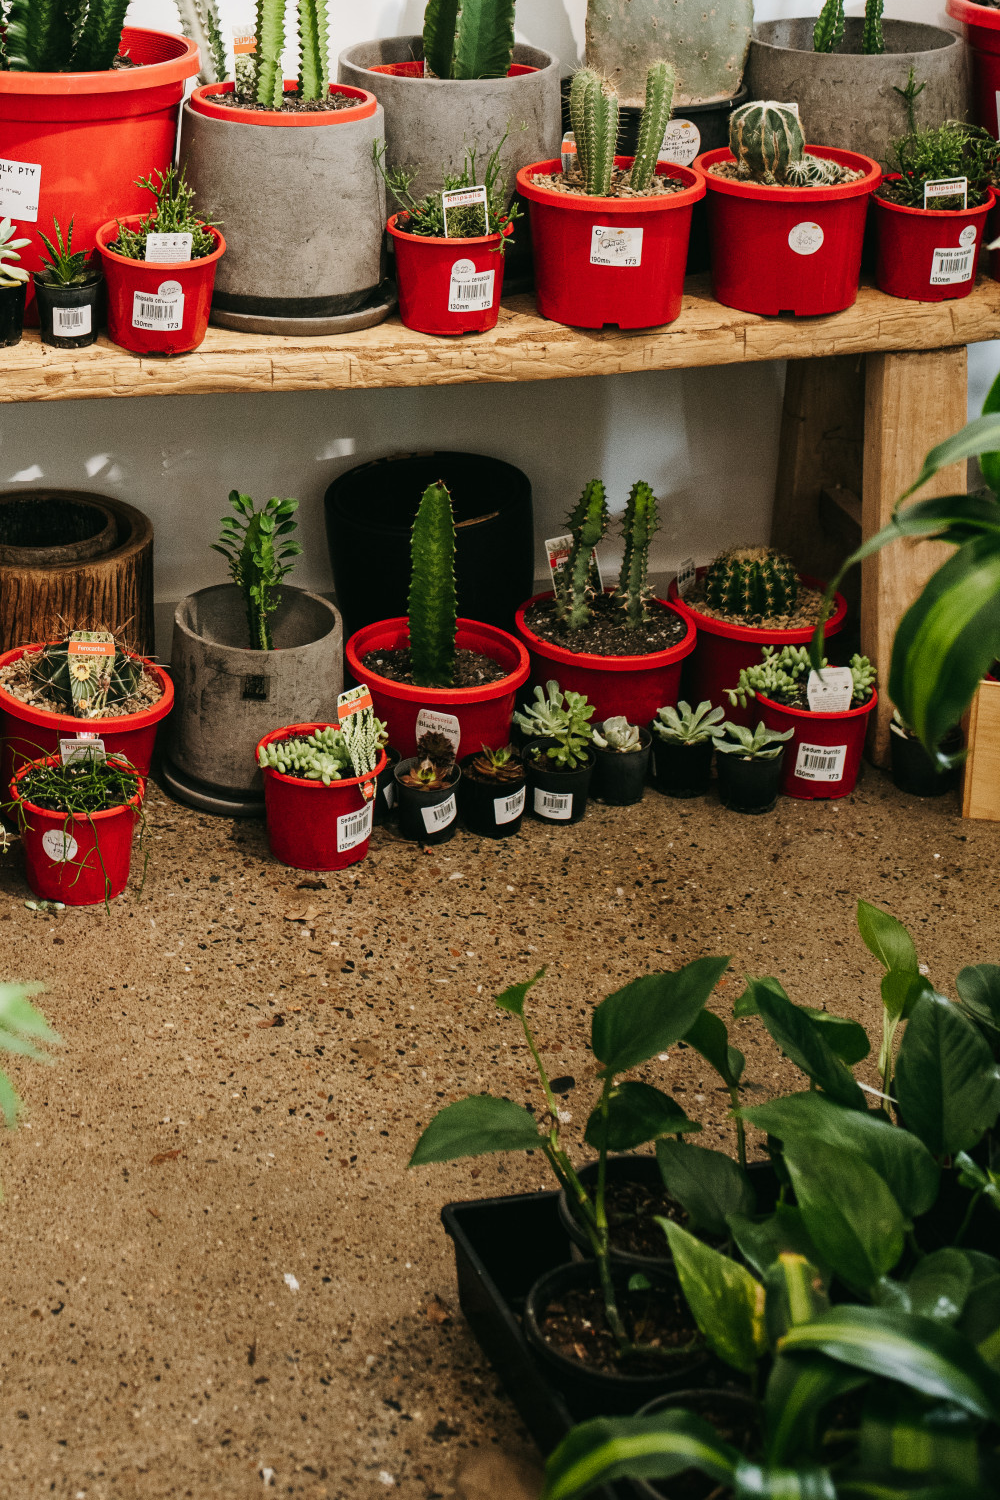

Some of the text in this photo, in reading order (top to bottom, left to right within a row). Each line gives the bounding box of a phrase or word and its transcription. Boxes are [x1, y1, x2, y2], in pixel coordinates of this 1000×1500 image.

[18, 167, 36, 176] PTY
[929, 183, 962, 191] Rhipsalis
[447, 192, 482, 202] Rhipsalis
[591, 256, 610, 264] 190mm
[133, 319, 153, 328] 130mm
[422, 712, 453, 724] Echeveria
[418, 719, 458, 735] Black Prince
[801, 745, 822, 754] Sedum
[796, 768, 815, 778] 130mm
[340, 814, 358, 825] Sedum
[339, 840, 356, 850] 130mm
